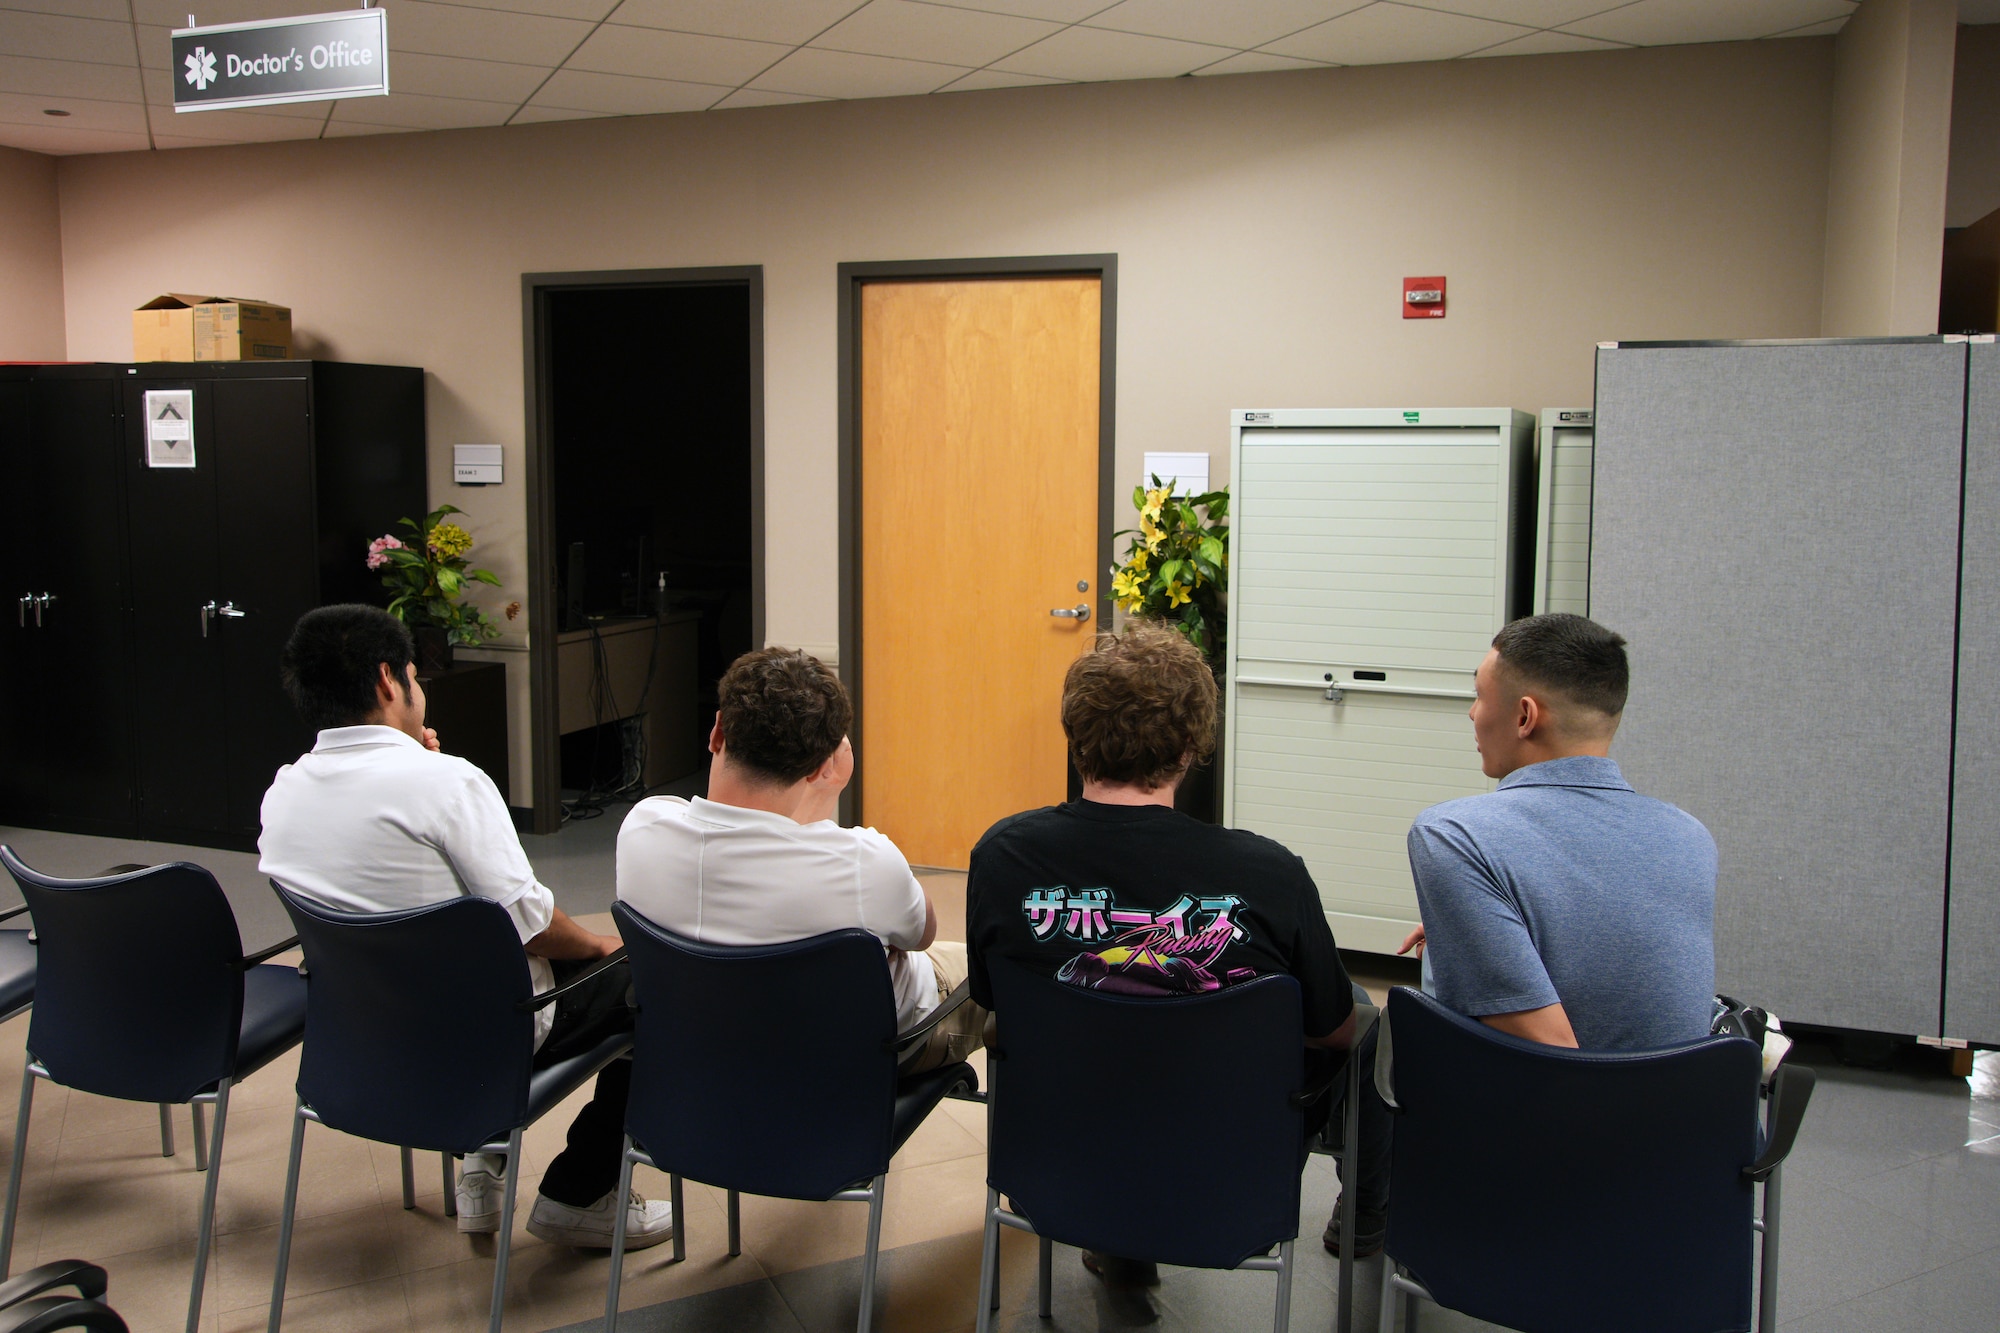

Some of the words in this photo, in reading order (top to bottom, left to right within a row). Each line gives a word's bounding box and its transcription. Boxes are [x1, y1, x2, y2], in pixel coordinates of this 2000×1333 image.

[227, 47, 303, 78] Doctor's
[310, 40, 373, 70] Office
[1115, 923, 1234, 977] Racing
